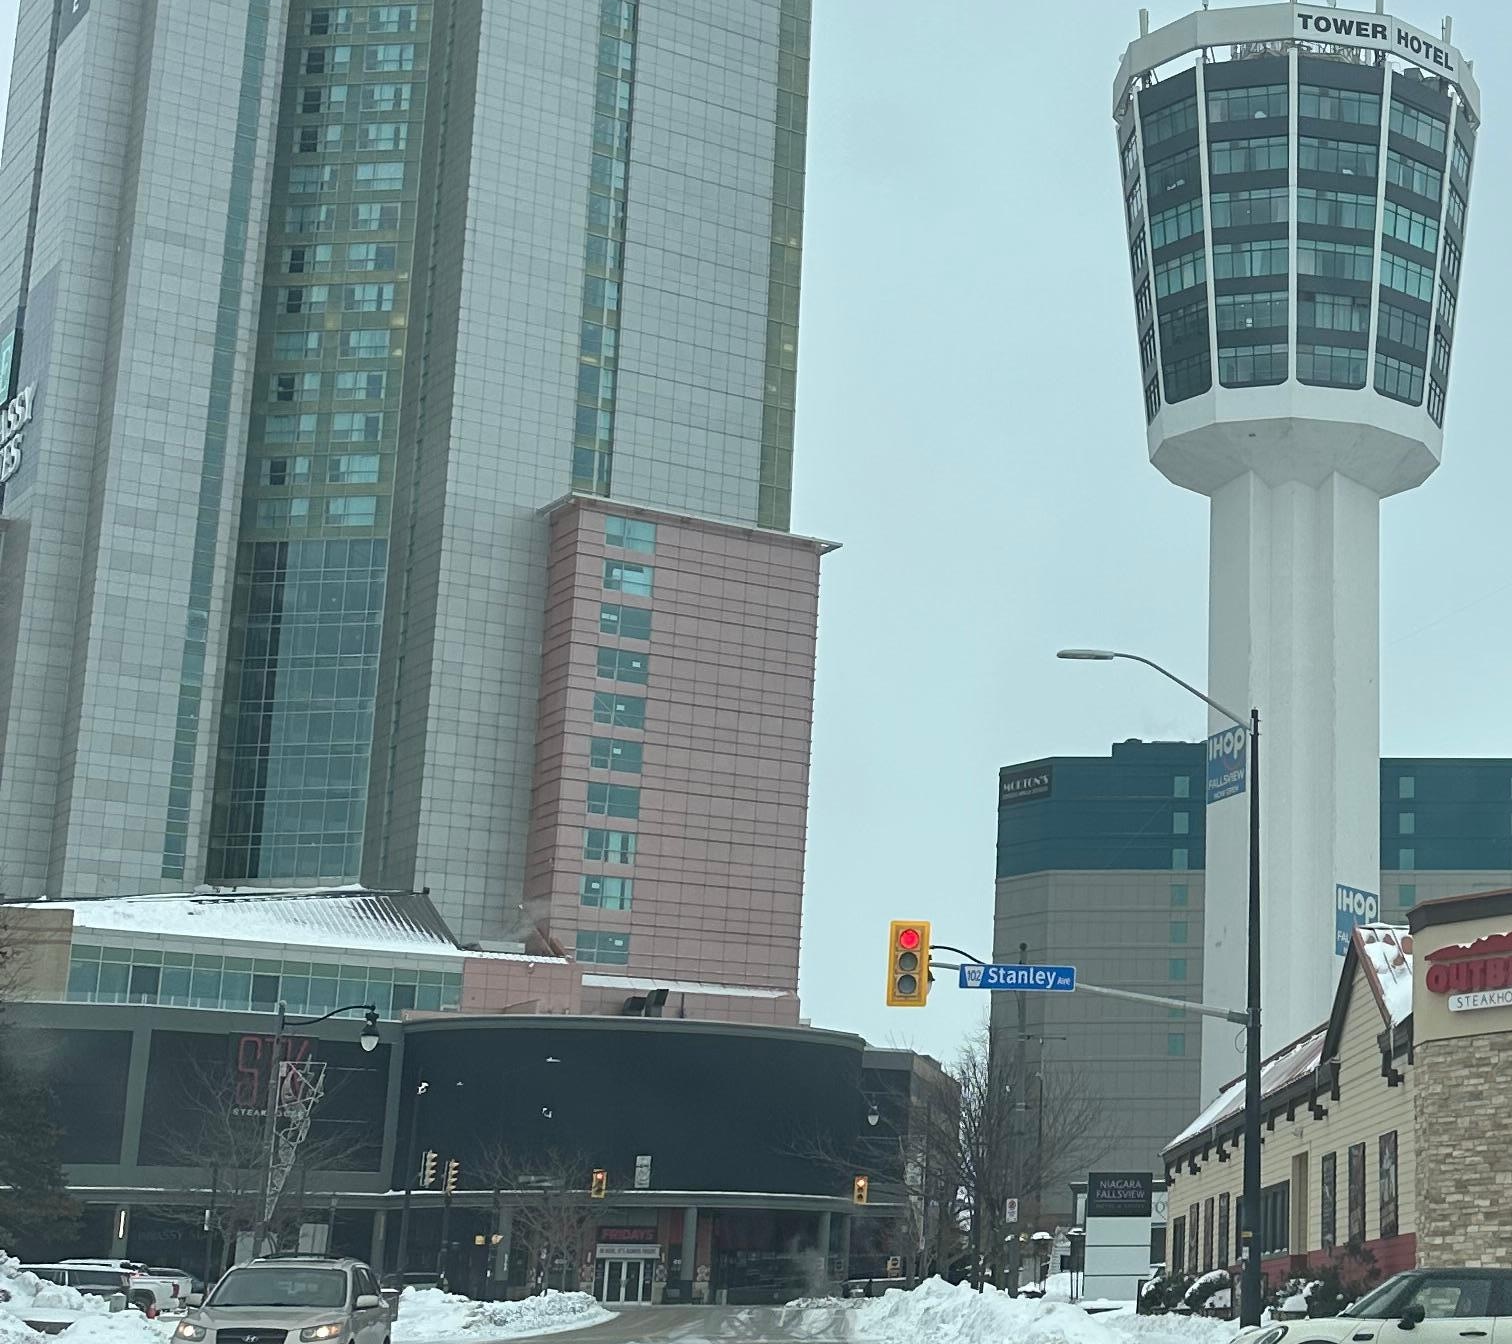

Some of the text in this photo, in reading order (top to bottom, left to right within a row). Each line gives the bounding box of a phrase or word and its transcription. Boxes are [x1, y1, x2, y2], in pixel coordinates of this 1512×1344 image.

[1297, 13, 1454, 72] TOWER HOTEL
[968, 967, 1071, 989] 102 Stanley Ave
[1100, 1179, 1142, 1189] NIAGARA
[1096, 1189, 1145, 1199] FALLSVIEW
